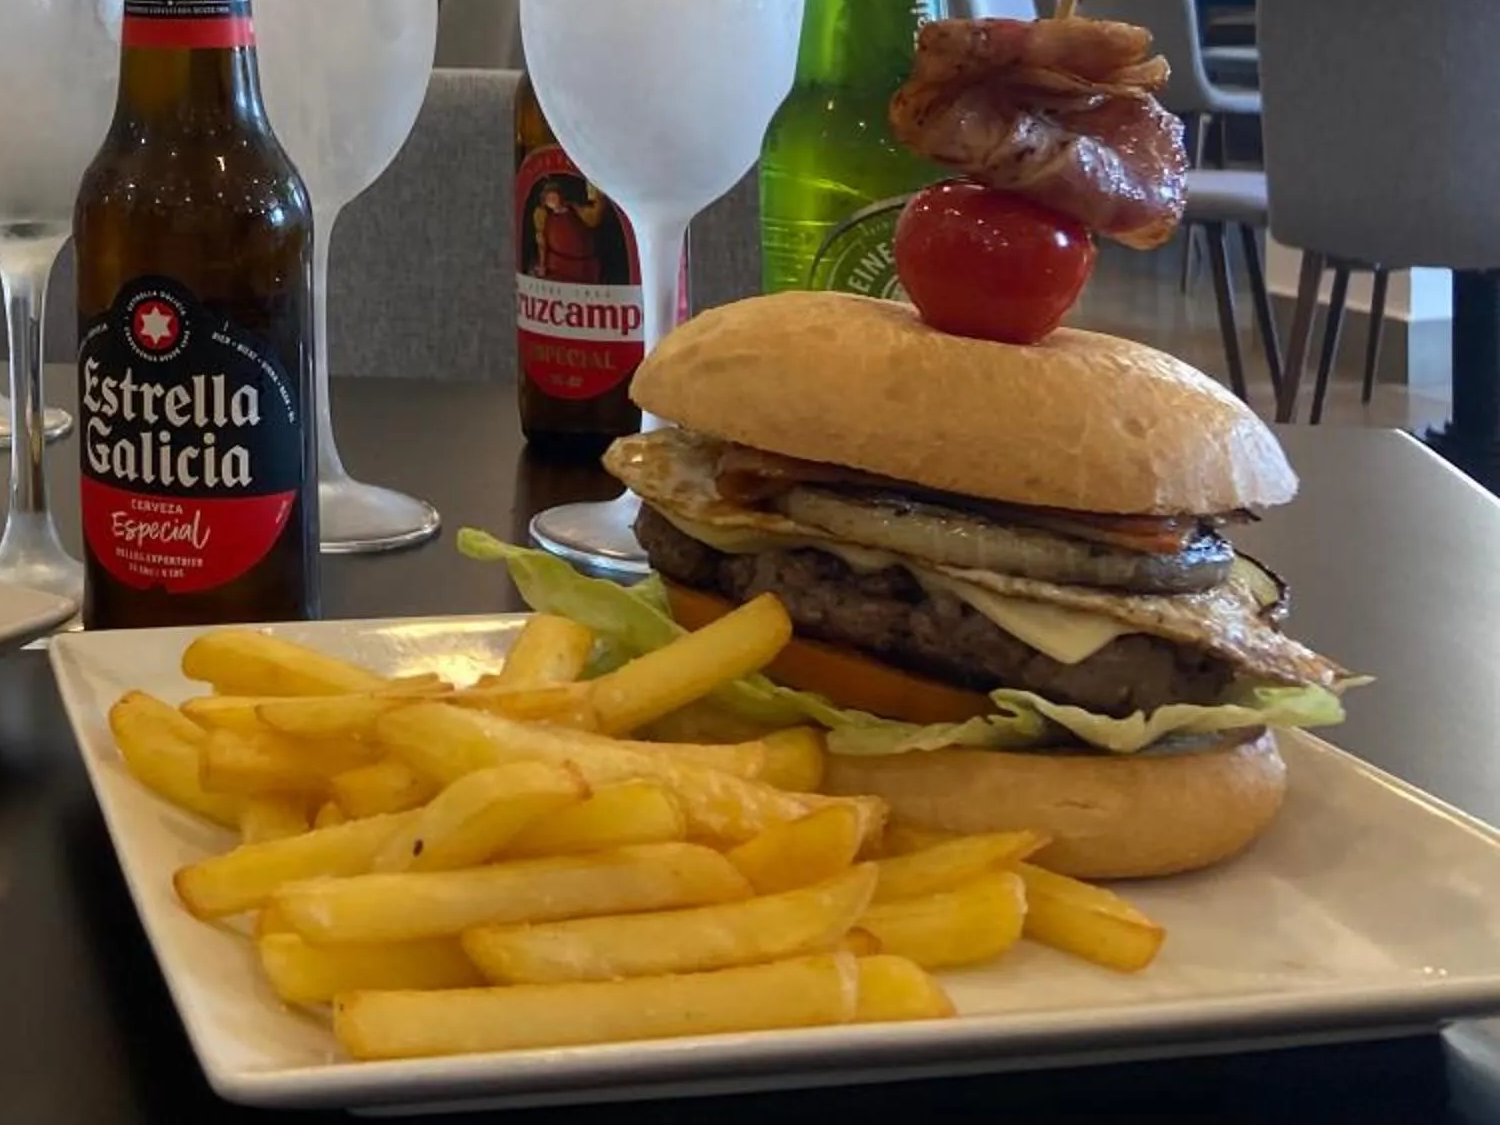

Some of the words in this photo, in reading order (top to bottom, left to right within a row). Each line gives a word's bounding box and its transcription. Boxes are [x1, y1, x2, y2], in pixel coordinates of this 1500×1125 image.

[847, 241, 896, 293] EINE
[518, 293, 643, 336] ruzcamp
[84, 356, 261, 427] Estrella
[87, 416, 253, 488] Galicia
[111, 509, 211, 550] Especial
[131, 498, 184, 515] CERVEZA
